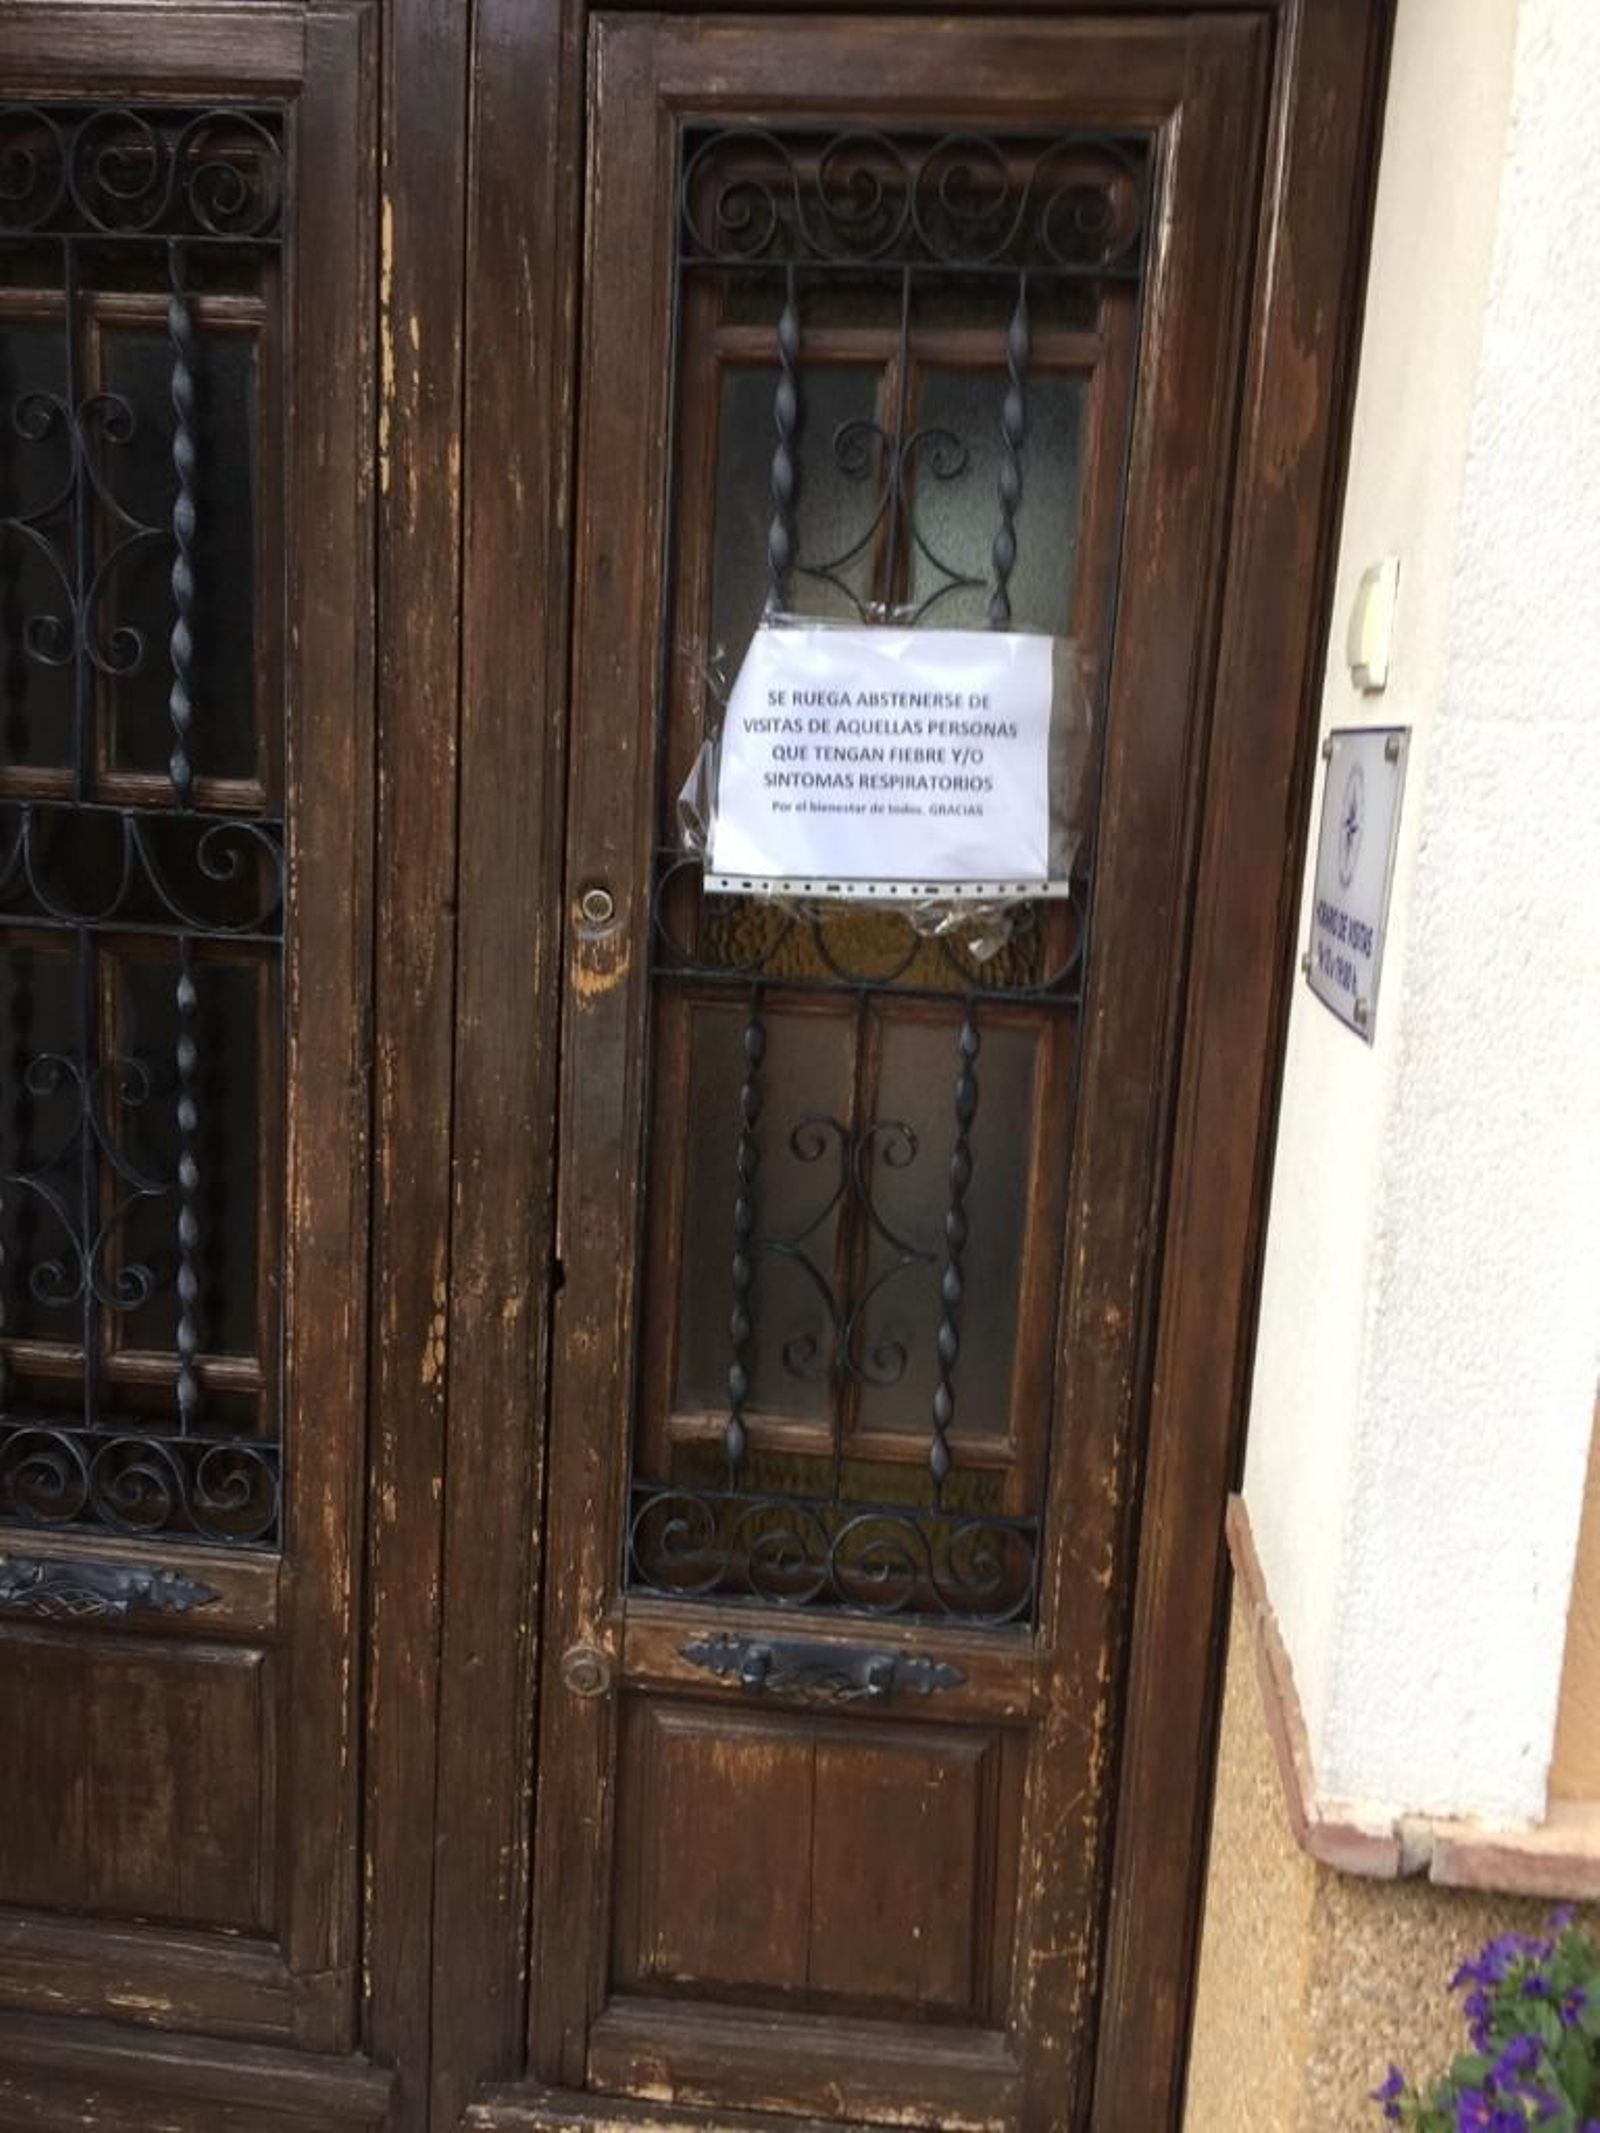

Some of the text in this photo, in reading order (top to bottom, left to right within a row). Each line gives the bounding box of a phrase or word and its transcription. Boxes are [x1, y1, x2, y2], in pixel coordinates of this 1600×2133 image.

[768, 690, 990, 710] SE RUEGA ABSTENERSE DE
[743, 717, 1018, 739] VISITAS DE AQUELLAS PERSONAS
[772, 744, 984, 766] QUE TENGAN FIEBRE Y/O
[764, 772, 994, 793] SINTOMAS RESPIRATORIOS
[772, 801, 792, 813] Por
[795, 800, 807, 813] el
[810, 800, 867, 815] bienestar
[870, 802, 885, 815] de
[928, 803, 984, 818] GRACIAS
